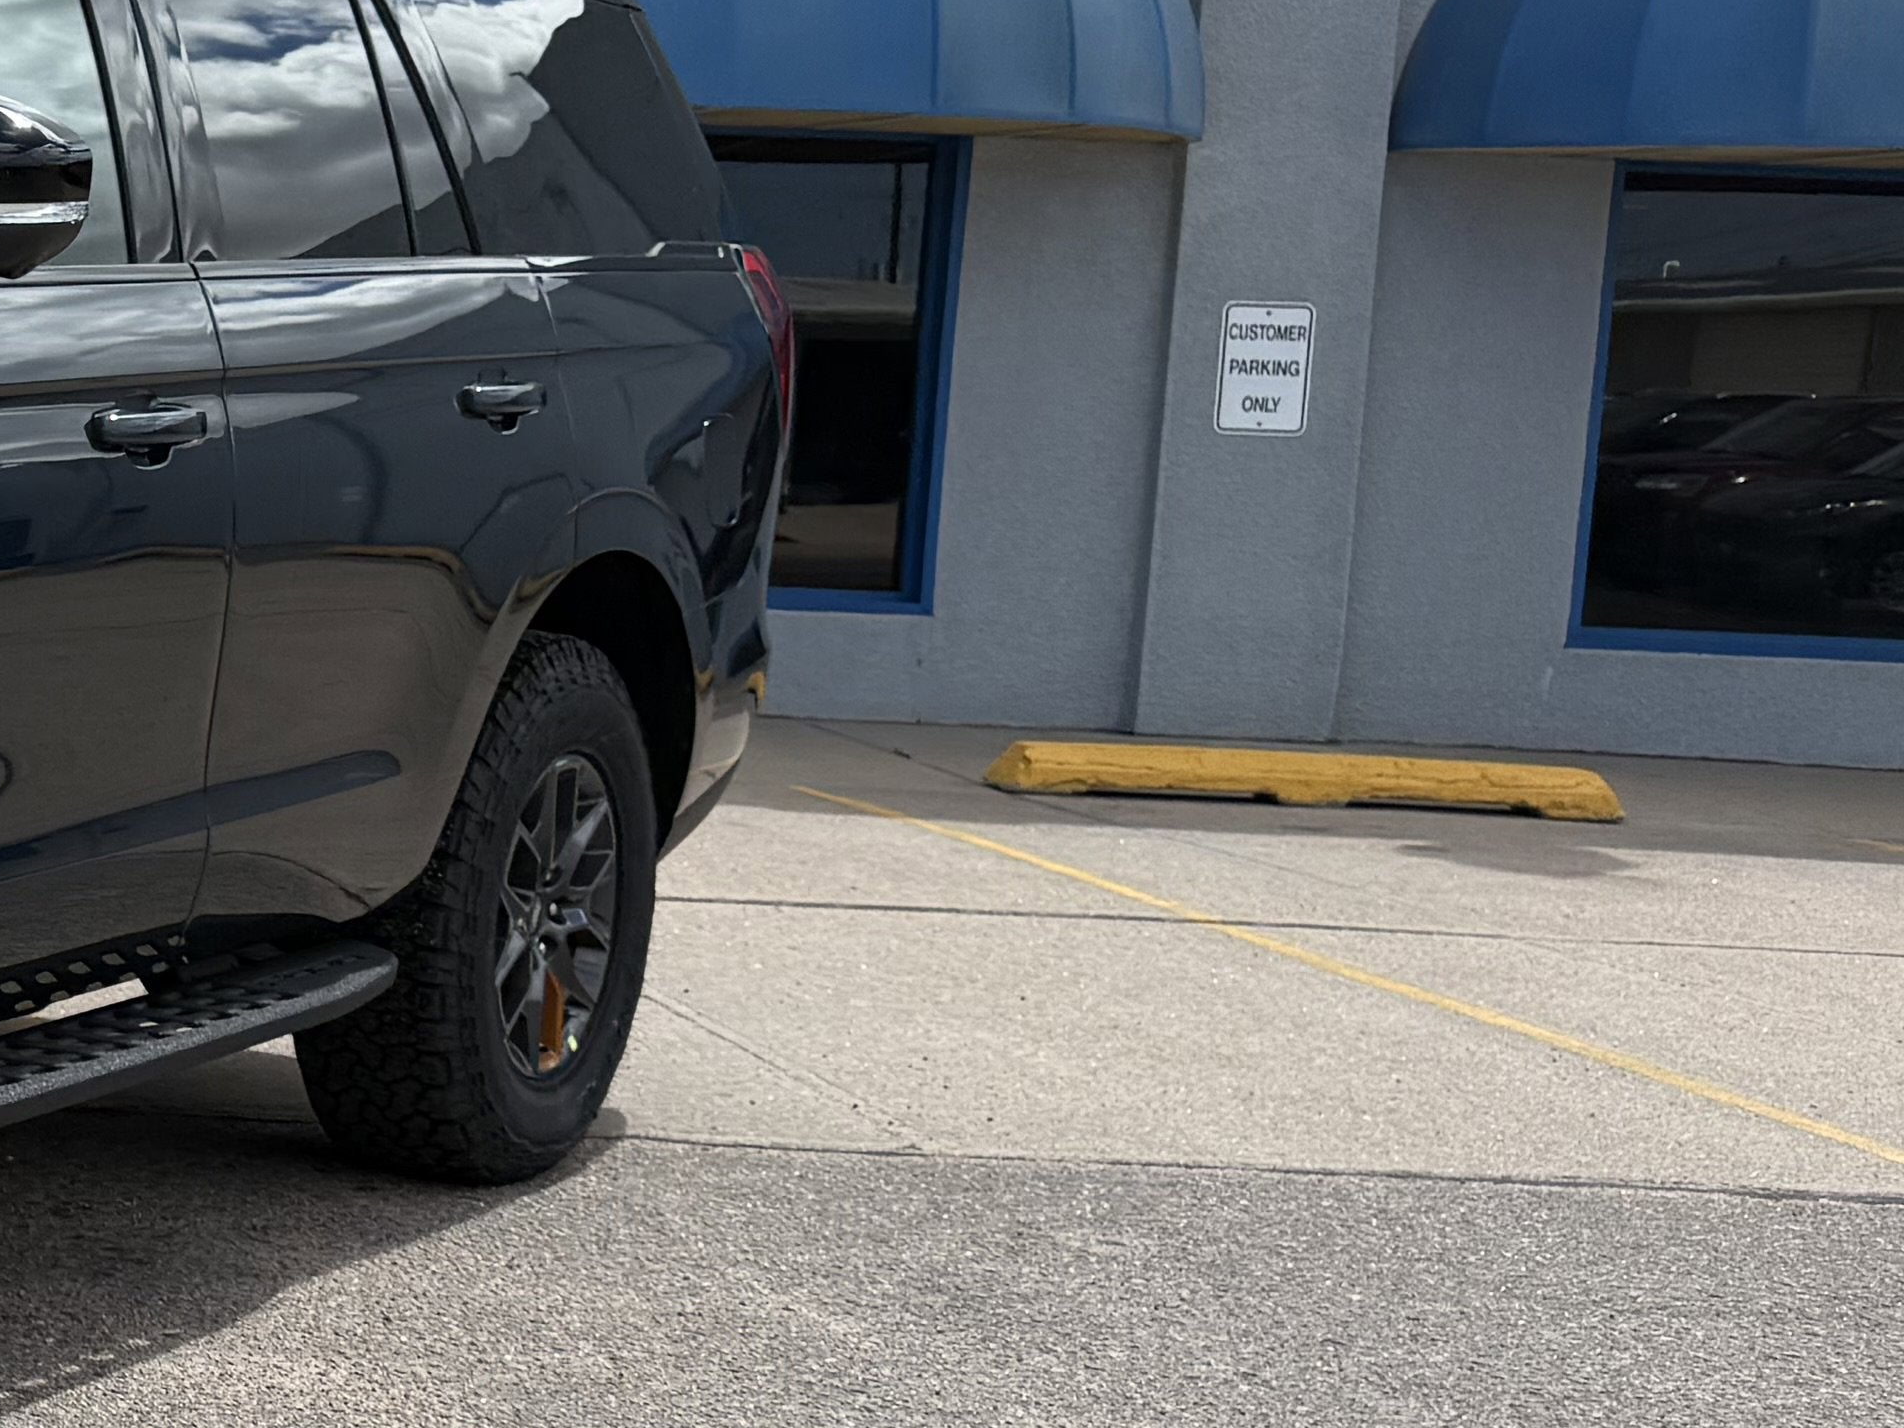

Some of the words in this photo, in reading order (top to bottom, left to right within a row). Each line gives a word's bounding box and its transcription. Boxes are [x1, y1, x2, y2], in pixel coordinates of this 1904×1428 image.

[1228, 323, 1307, 342] CUSTOMER
[1228, 358, 1300, 377] PARKING
[1241, 395, 1281, 413] ONLY
